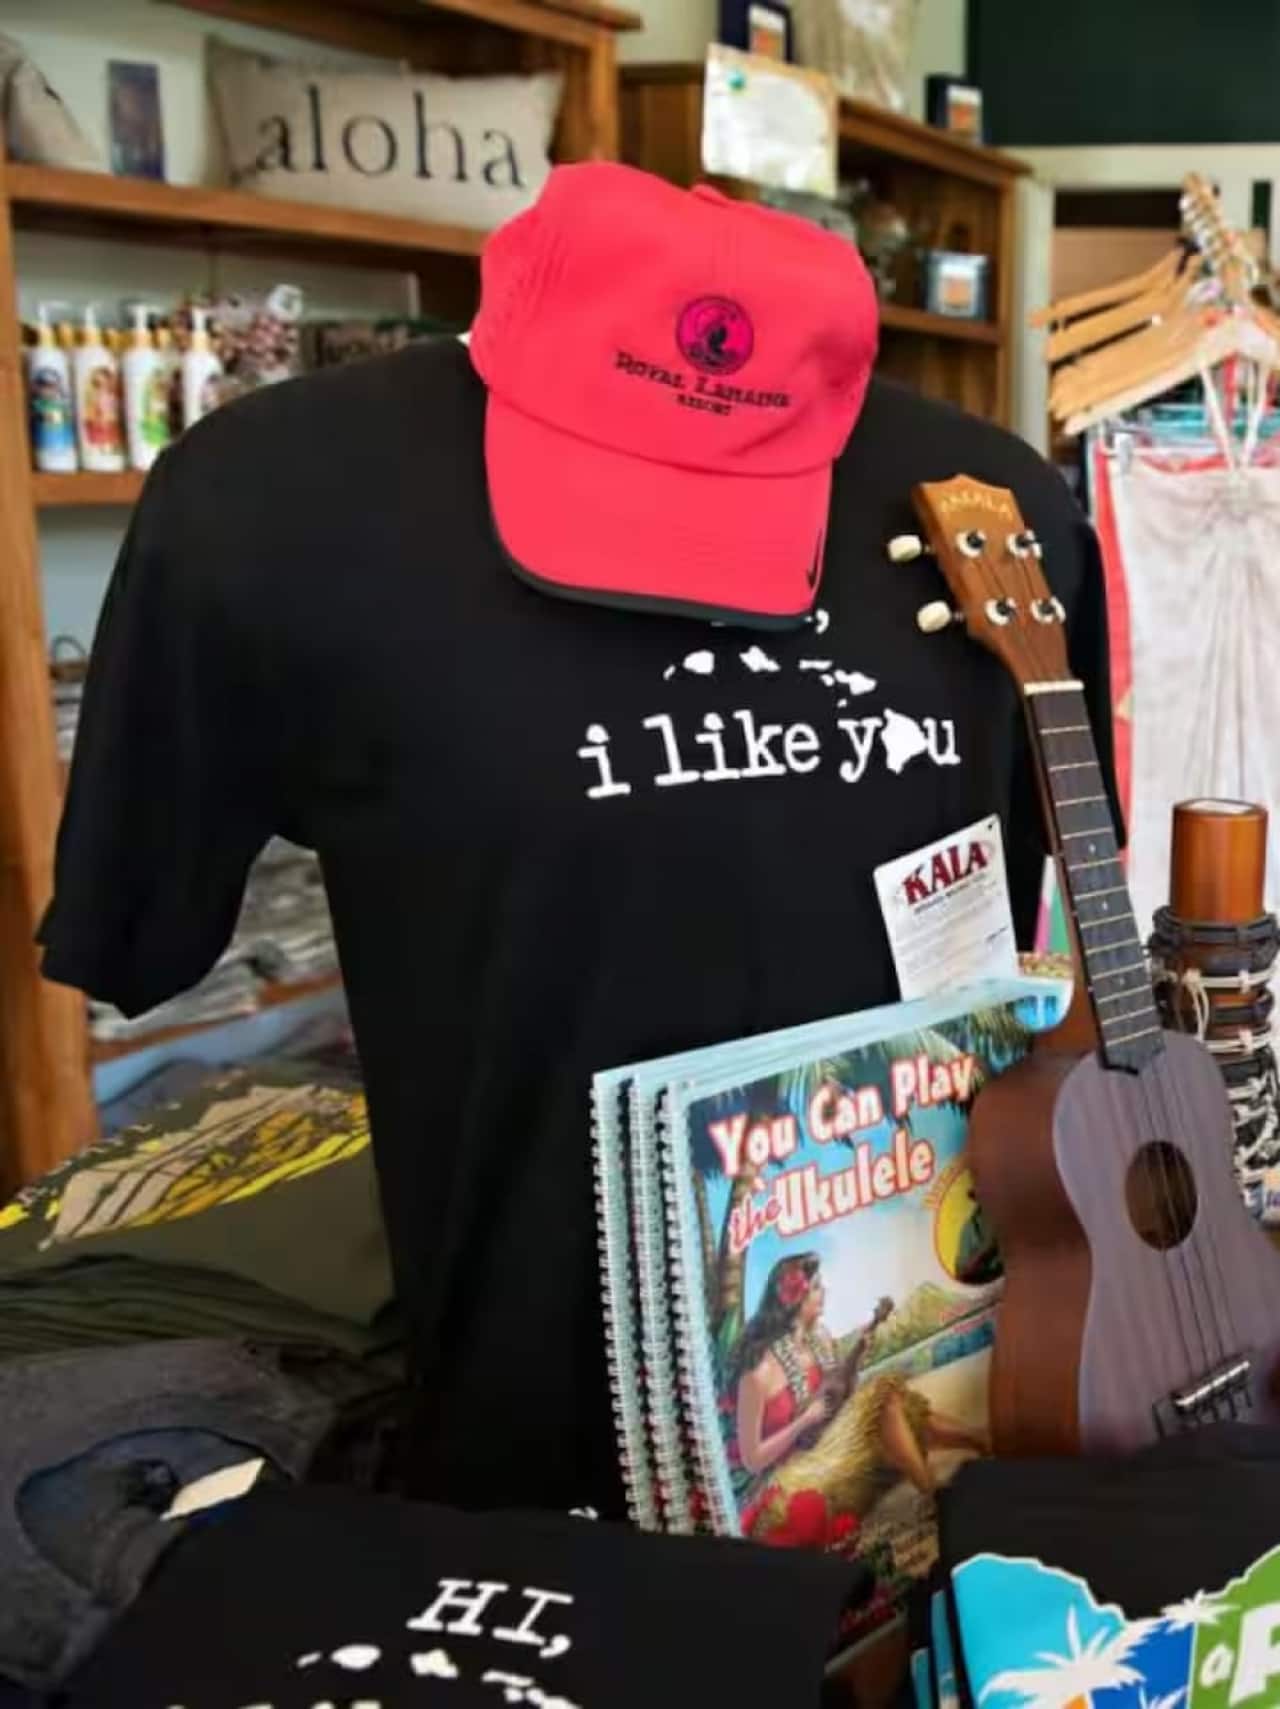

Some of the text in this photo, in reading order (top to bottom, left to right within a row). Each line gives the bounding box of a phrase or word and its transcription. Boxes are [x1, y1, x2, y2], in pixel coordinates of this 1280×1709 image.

[255, 83, 526, 188] aloha
[578, 724, 631, 798] i
[643, 709, 821, 785] like
[902, 841, 989, 906] KALA
[708, 1054, 976, 1178] You Can Play
[775, 1127, 936, 1238] Ukulele
[406, 1578, 574, 1659] HI,
[1200, 1643, 1234, 1688] a
